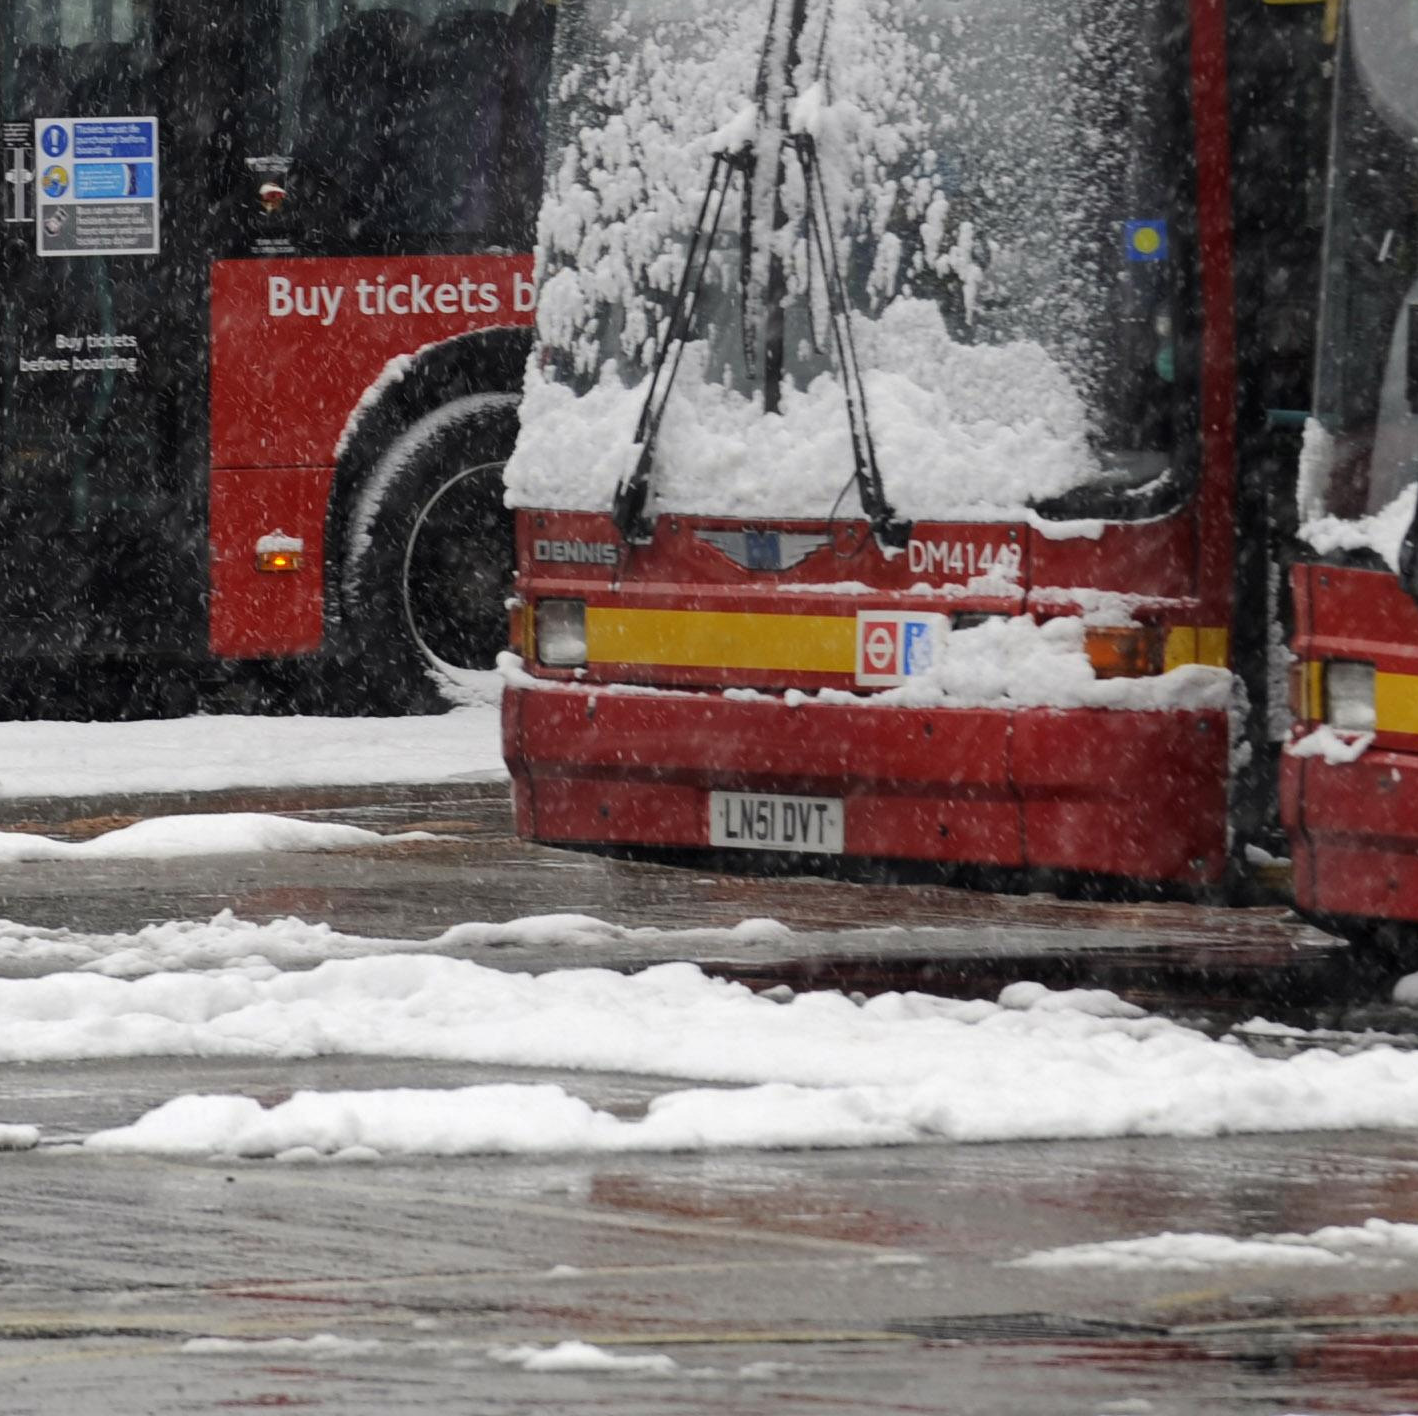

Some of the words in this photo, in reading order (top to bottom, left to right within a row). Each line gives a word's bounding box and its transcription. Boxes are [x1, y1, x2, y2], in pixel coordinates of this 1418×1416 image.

[268, 276, 343, 326] Buy
[356, 274, 500, 315] tickets
[56, 334, 83, 352] Buy
[86, 333, 137, 347] tickets
[19, 356, 70, 372] before
[72, 355, 137, 373] boarding
[534, 539, 618, 564] DENNIS
[724, 798, 776, 841] LN51
[782, 801, 828, 844] DVT
